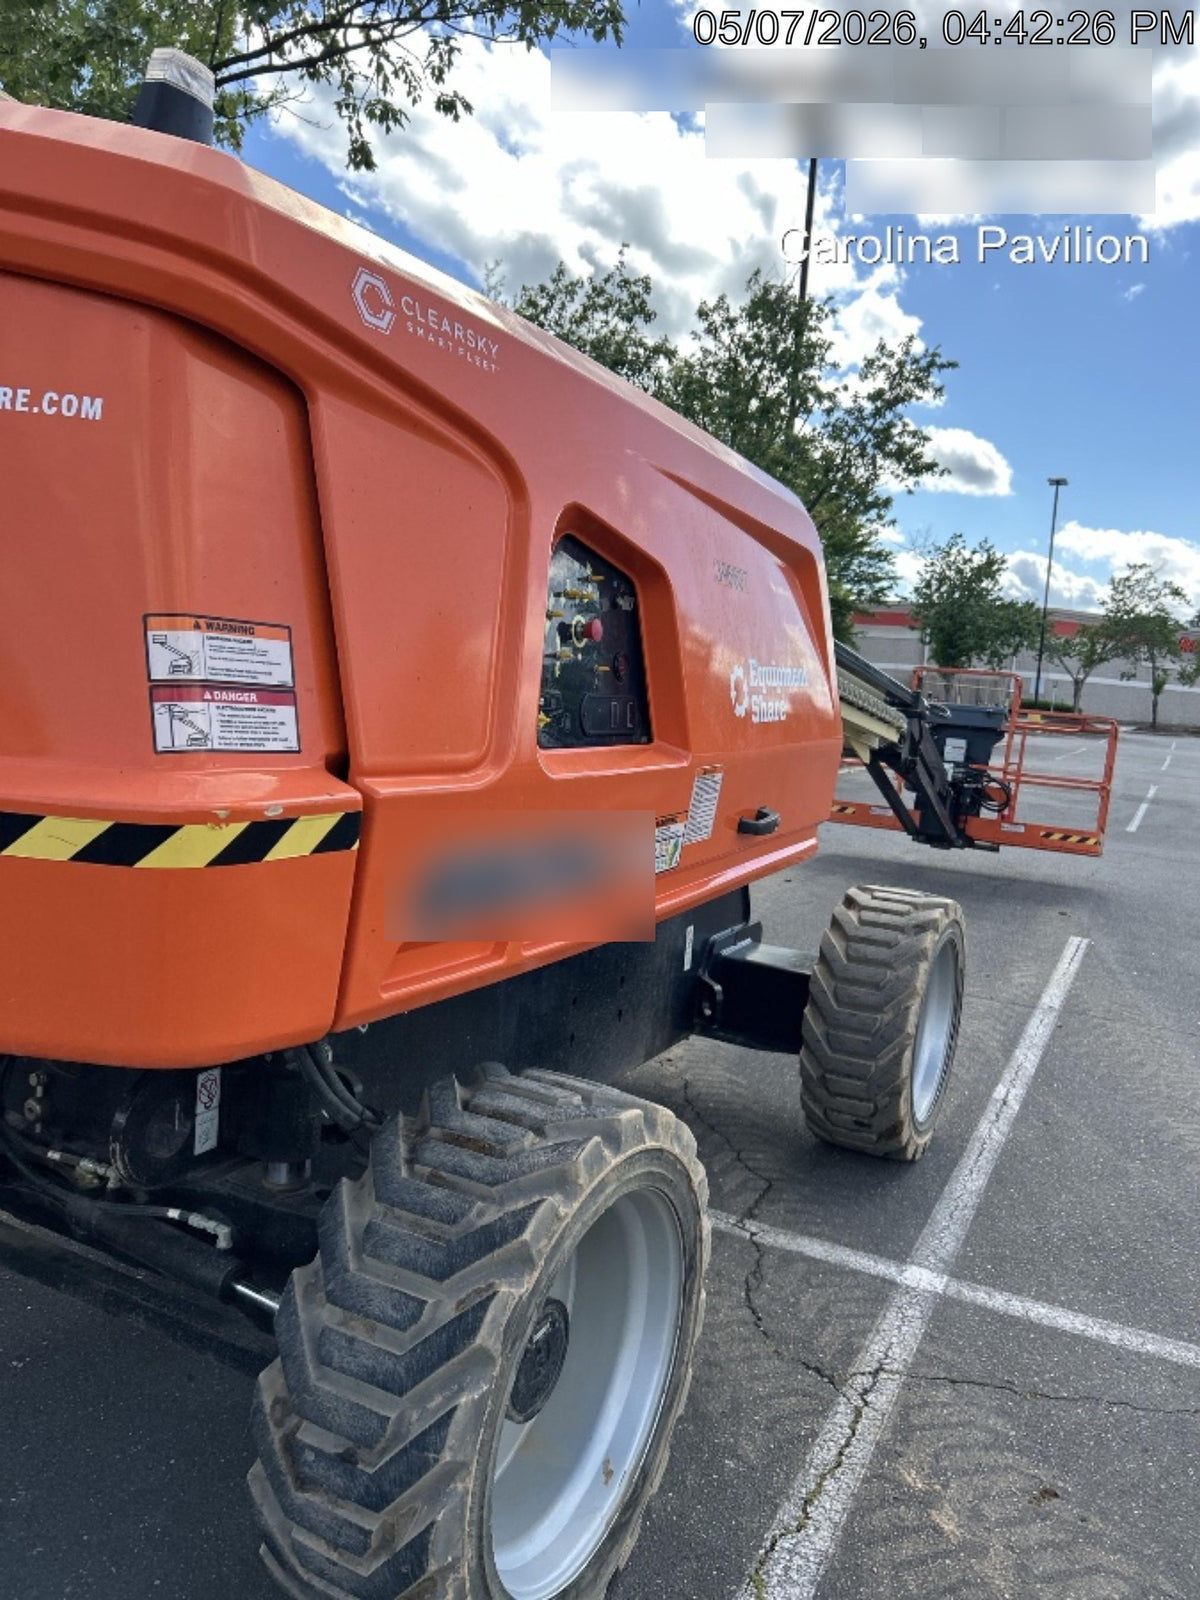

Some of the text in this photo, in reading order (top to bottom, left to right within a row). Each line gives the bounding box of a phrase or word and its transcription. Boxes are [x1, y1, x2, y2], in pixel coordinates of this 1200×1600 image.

[401, 296, 499, 360] CLEARSKY
[205, 621, 255, 636] WARNING
[213, 690, 258, 703] DANGER
